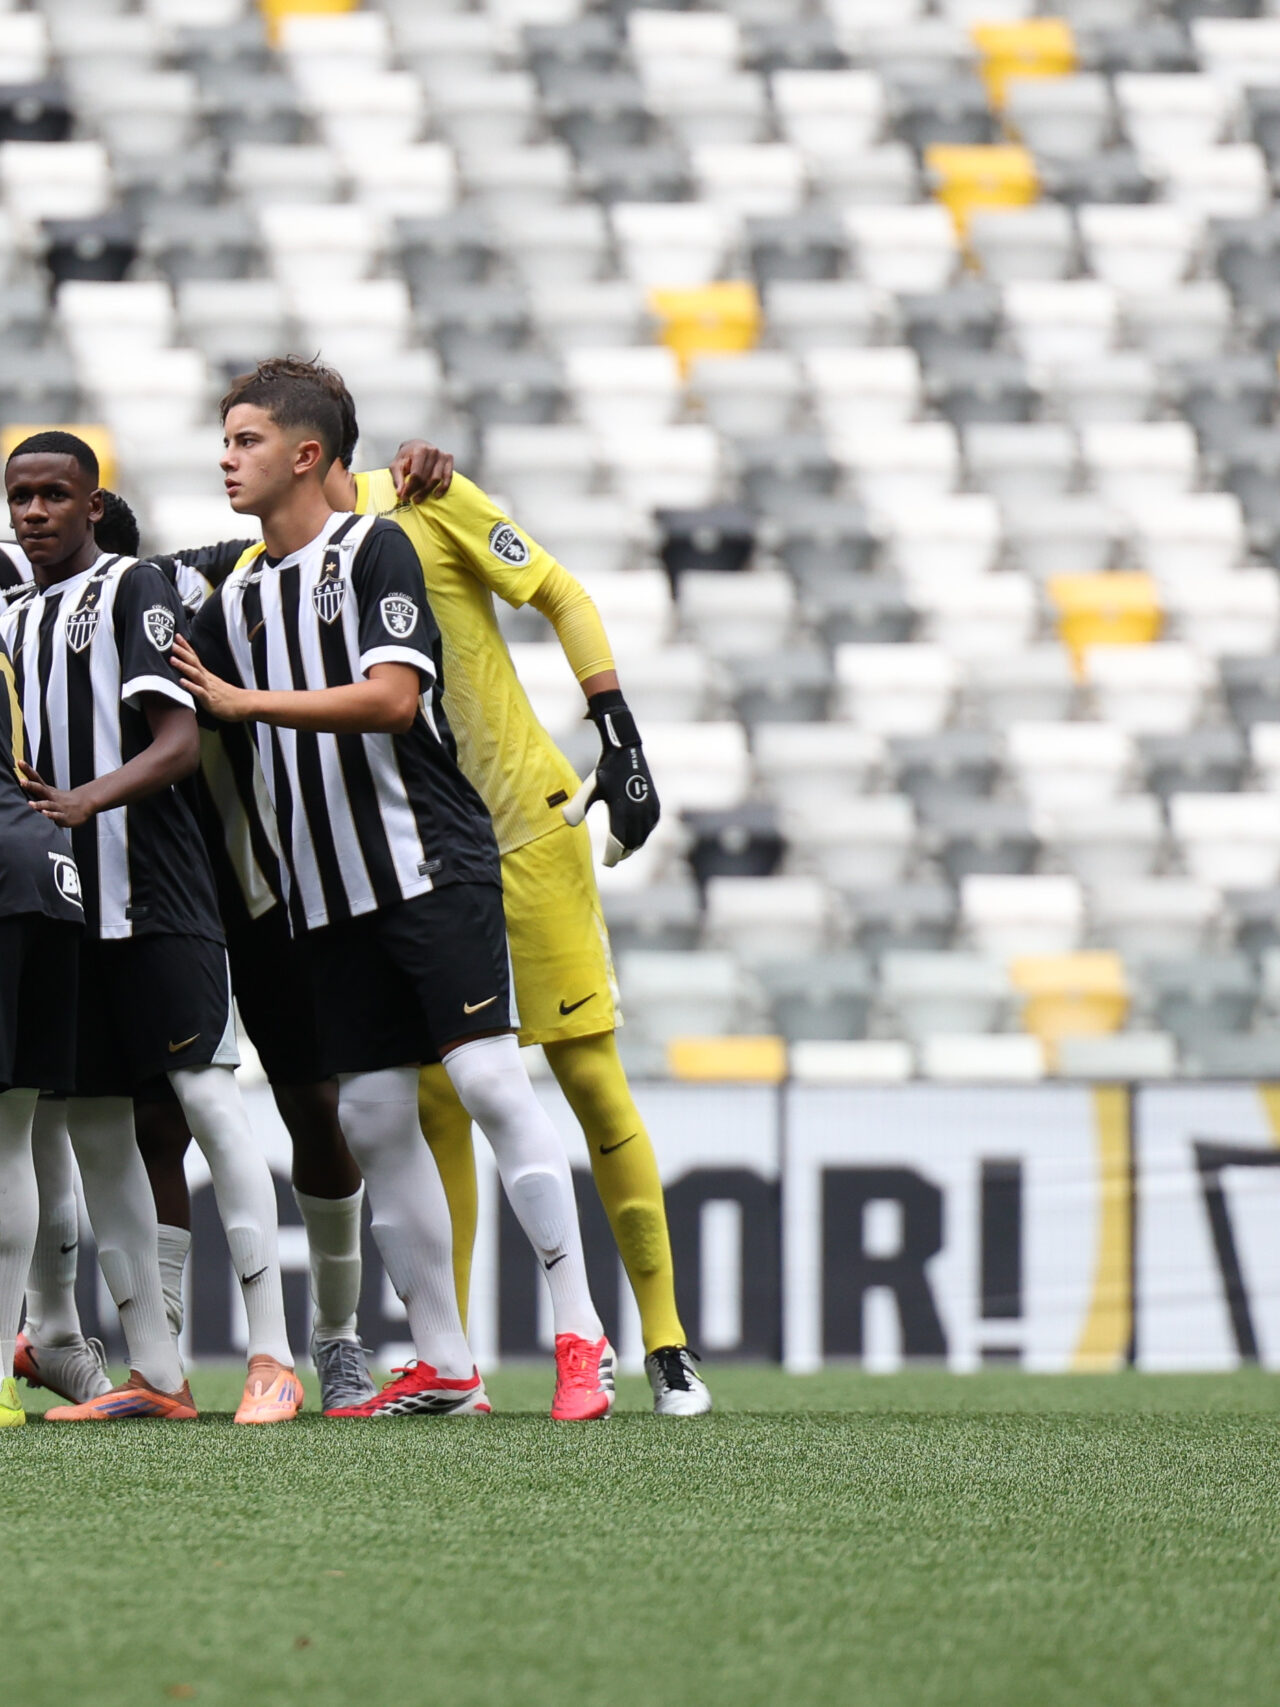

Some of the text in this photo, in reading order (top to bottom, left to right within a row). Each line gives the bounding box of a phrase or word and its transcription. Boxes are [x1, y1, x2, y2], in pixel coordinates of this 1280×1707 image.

[315, 582, 341, 595] CAM
[391, 602, 409, 615] M2
[70, 612, 97, 623] CAM
[155, 614, 170, 628] M2
[62, 864, 82, 898] B
